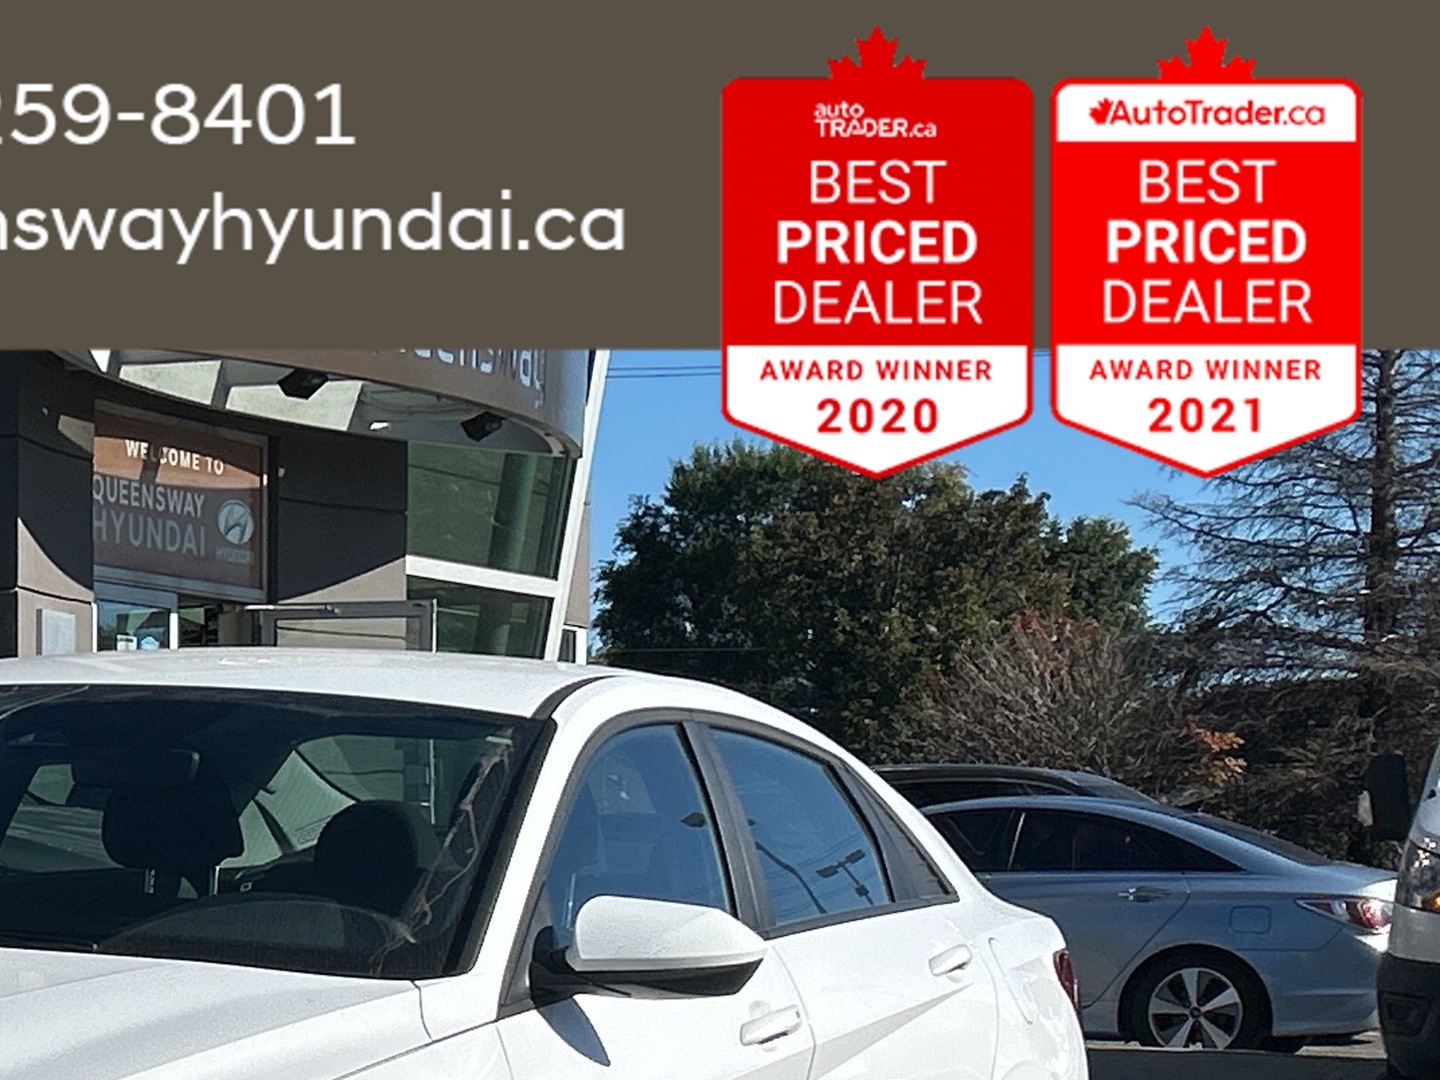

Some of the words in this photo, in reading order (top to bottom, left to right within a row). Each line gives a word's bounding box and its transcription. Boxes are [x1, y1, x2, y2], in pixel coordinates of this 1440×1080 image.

[125, 439, 201, 470] WELCOME
[206, 456, 224, 475] TO
[93, 474, 205, 519] QUEENSWAY
[93, 508, 205, 557] HYUNDAI
